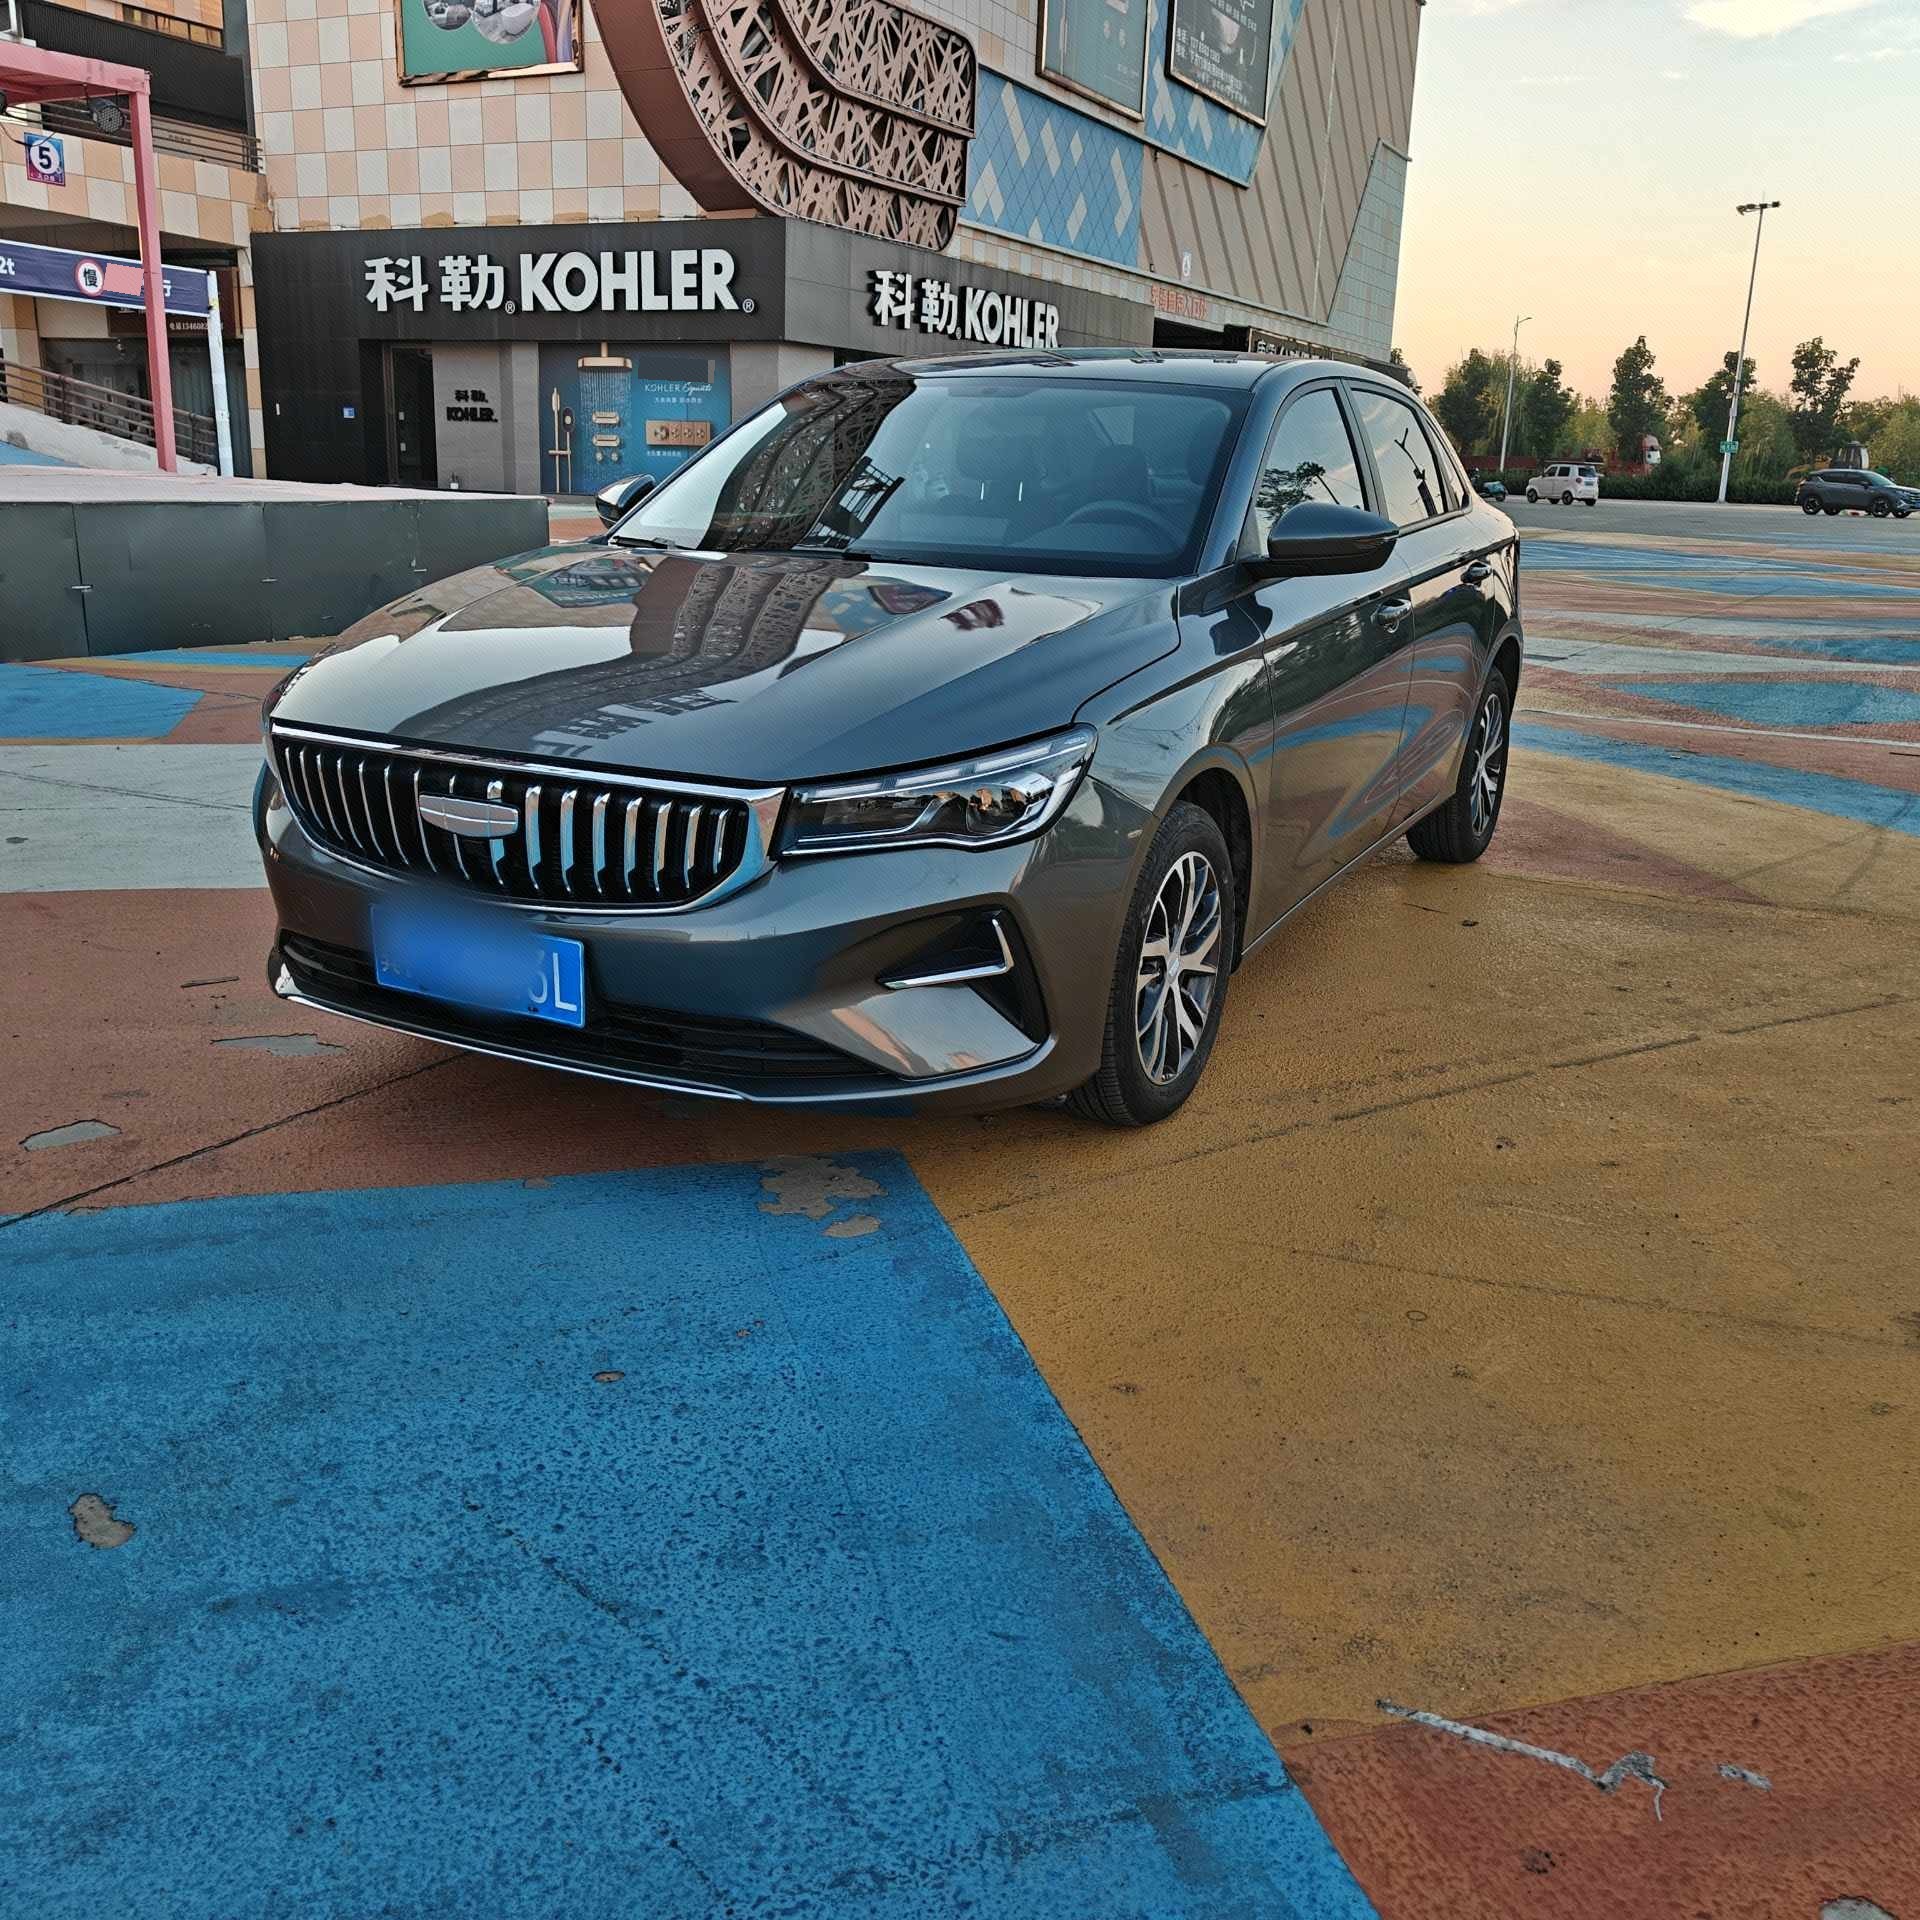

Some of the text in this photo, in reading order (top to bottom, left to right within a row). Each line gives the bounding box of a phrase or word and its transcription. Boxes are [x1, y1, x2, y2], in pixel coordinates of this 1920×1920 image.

[38, 146, 52, 170] 5
[83, 267, 98, 288] 慢
[363, 249, 740, 312] 科勒 KOHLER
[873, 269, 1060, 348] 科勒 KOHLER
[446, 406, 495, 422] KOHLER
